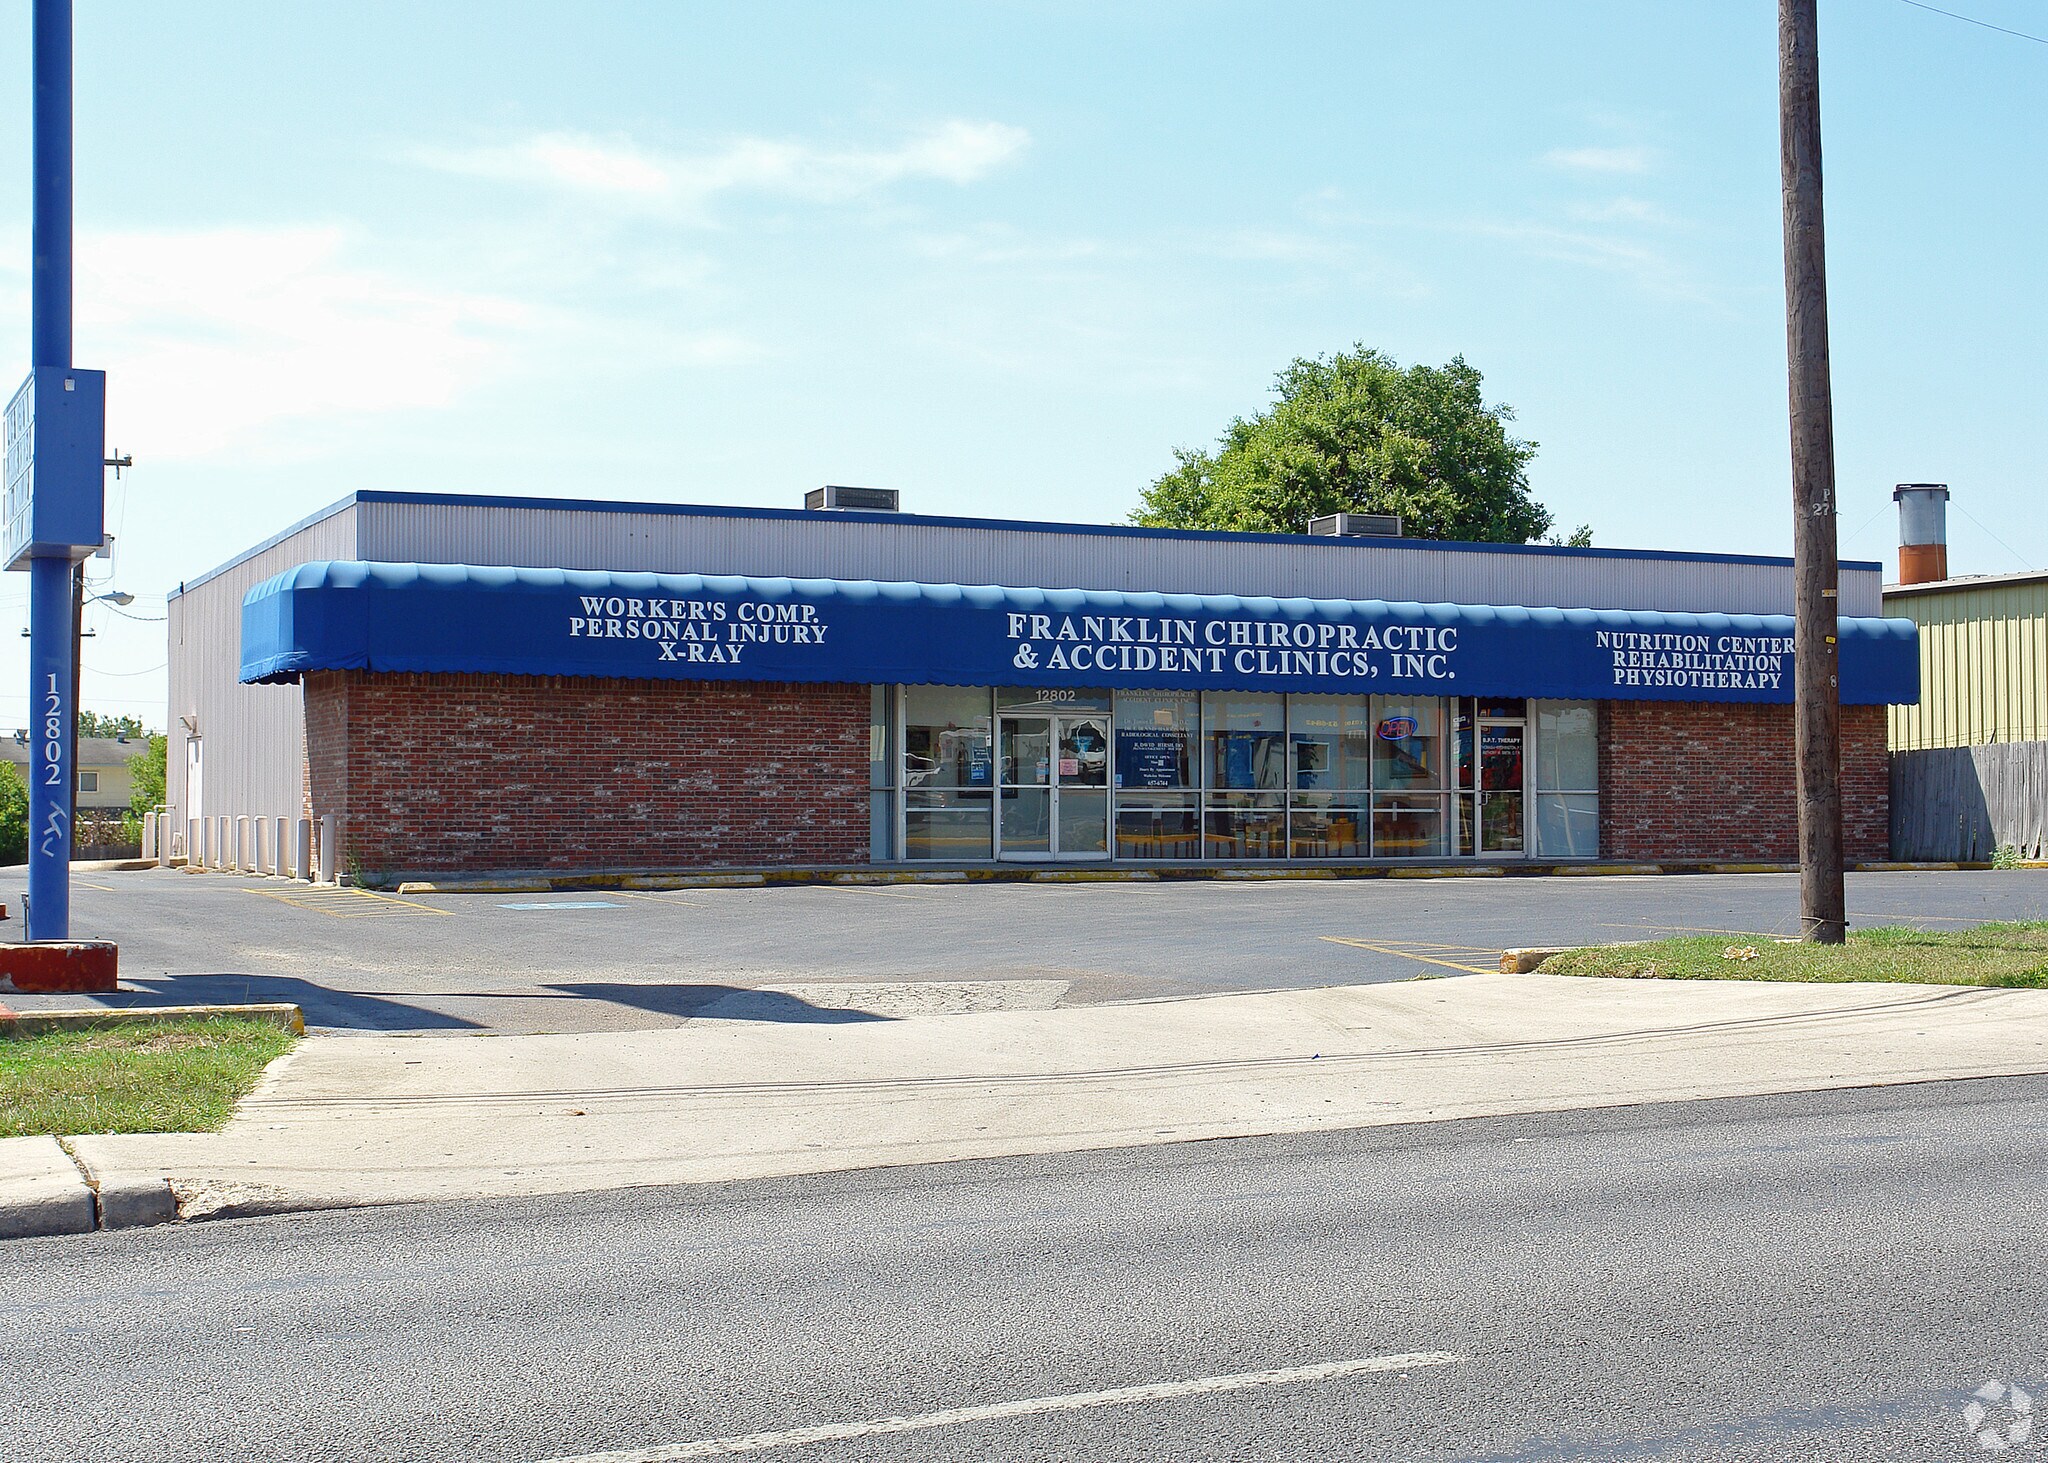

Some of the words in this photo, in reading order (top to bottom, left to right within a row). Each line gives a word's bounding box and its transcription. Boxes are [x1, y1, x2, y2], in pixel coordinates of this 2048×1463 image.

[580, 596, 727, 620] WORKER'S
[737, 602, 819, 624] COMP.
[569, 617, 718, 642] PERSONAL
[728, 623, 829, 644] INJURY
[1006, 612, 1197, 645] FRANKLIN
[1204, 620, 1457, 651] CHIROPRACTIC
[1596, 630, 1710, 653] NUTRITION
[1717, 636, 1796, 654] CENTER
[658, 641, 745, 663] X-RAY
[1013, 643, 1039, 669] &
[1046, 644, 1227, 673] ACCIDENT
[1234, 649, 1378, 677] CLINICS,
[1390, 653, 1456, 679] INC.
[1612, 650, 1782, 672] REHABILITATION
[1613, 668, 1782, 689] PHYSIOTHERAPY
[1035, 689, 1076, 702] 12802
[45, 672, 62, 785] 12802
[1381, 721, 1413, 736] OPEN
